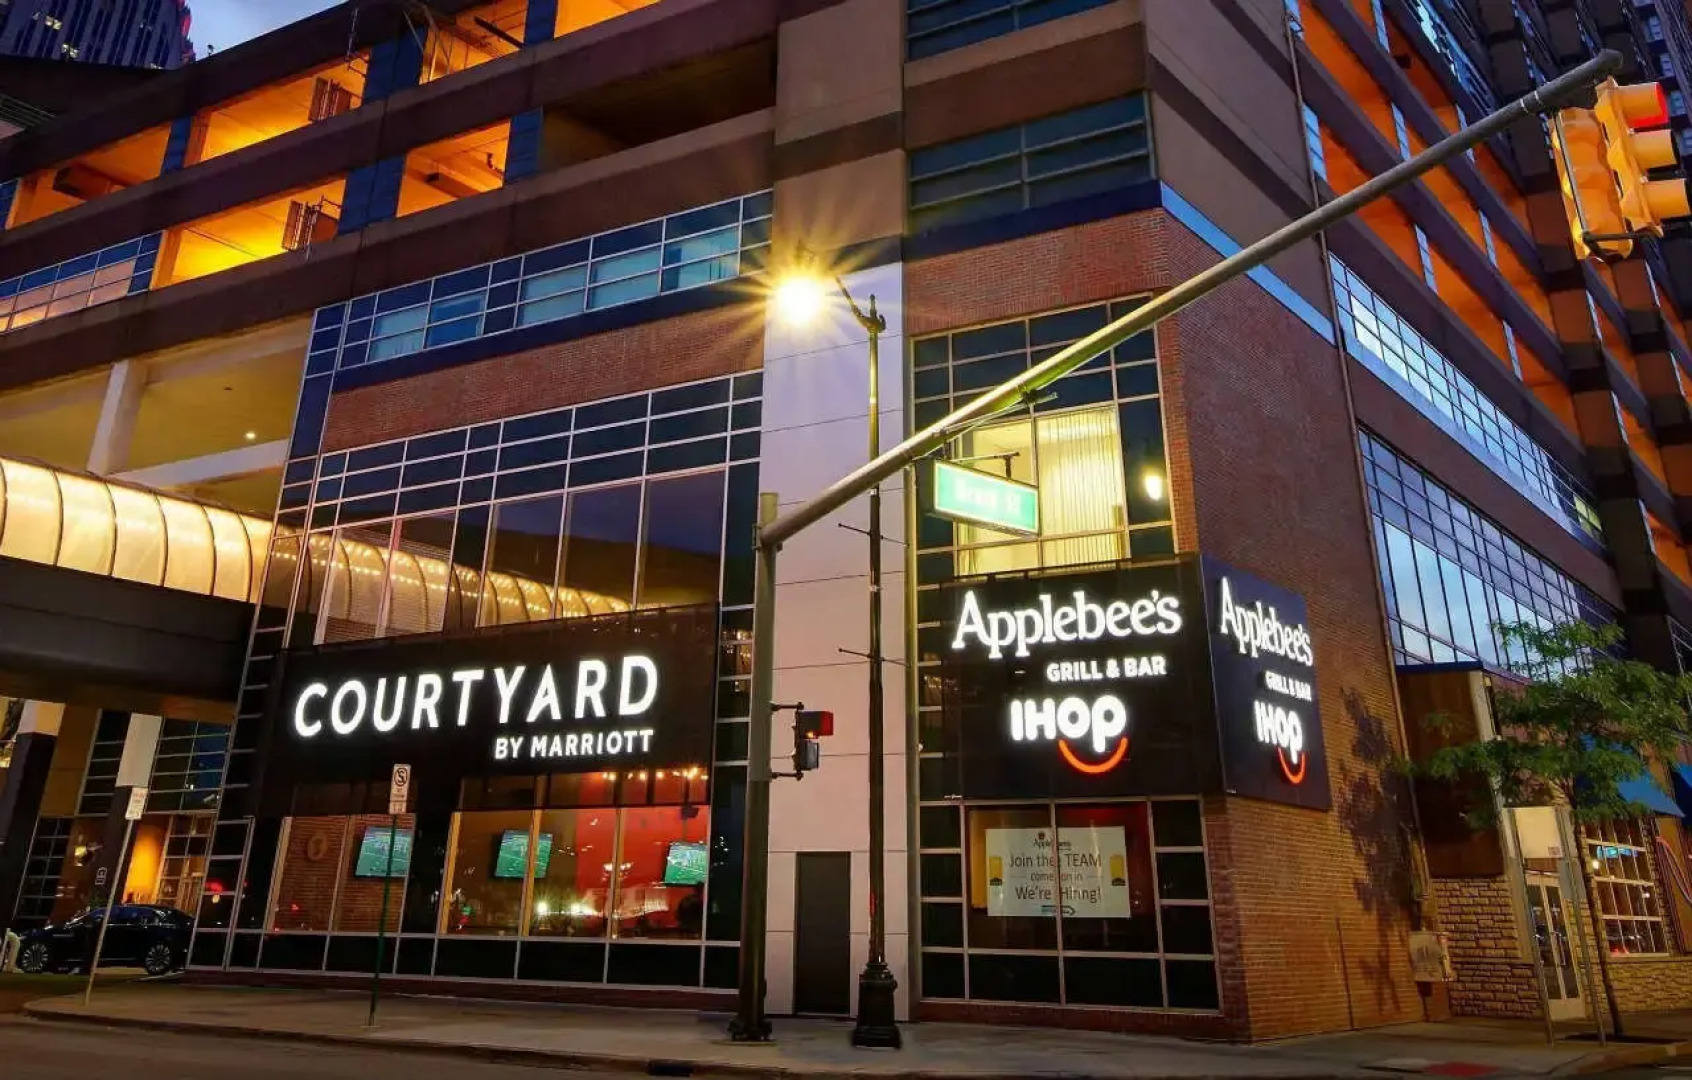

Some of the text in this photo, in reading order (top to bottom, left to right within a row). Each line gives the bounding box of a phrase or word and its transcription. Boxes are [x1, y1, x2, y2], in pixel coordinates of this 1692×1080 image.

[951, 588, 1184, 659] Applebee's
[1219, 575, 1315, 667] Applebee's
[1046, 656, 1168, 683] GRILL & BAR
[293, 653, 660, 739] COURTYARD
[494, 728, 655, 761] BY MARRIOTT
[1010, 853, 1102, 868] Join the TEAM
[1015, 886, 1052, 900] We're
